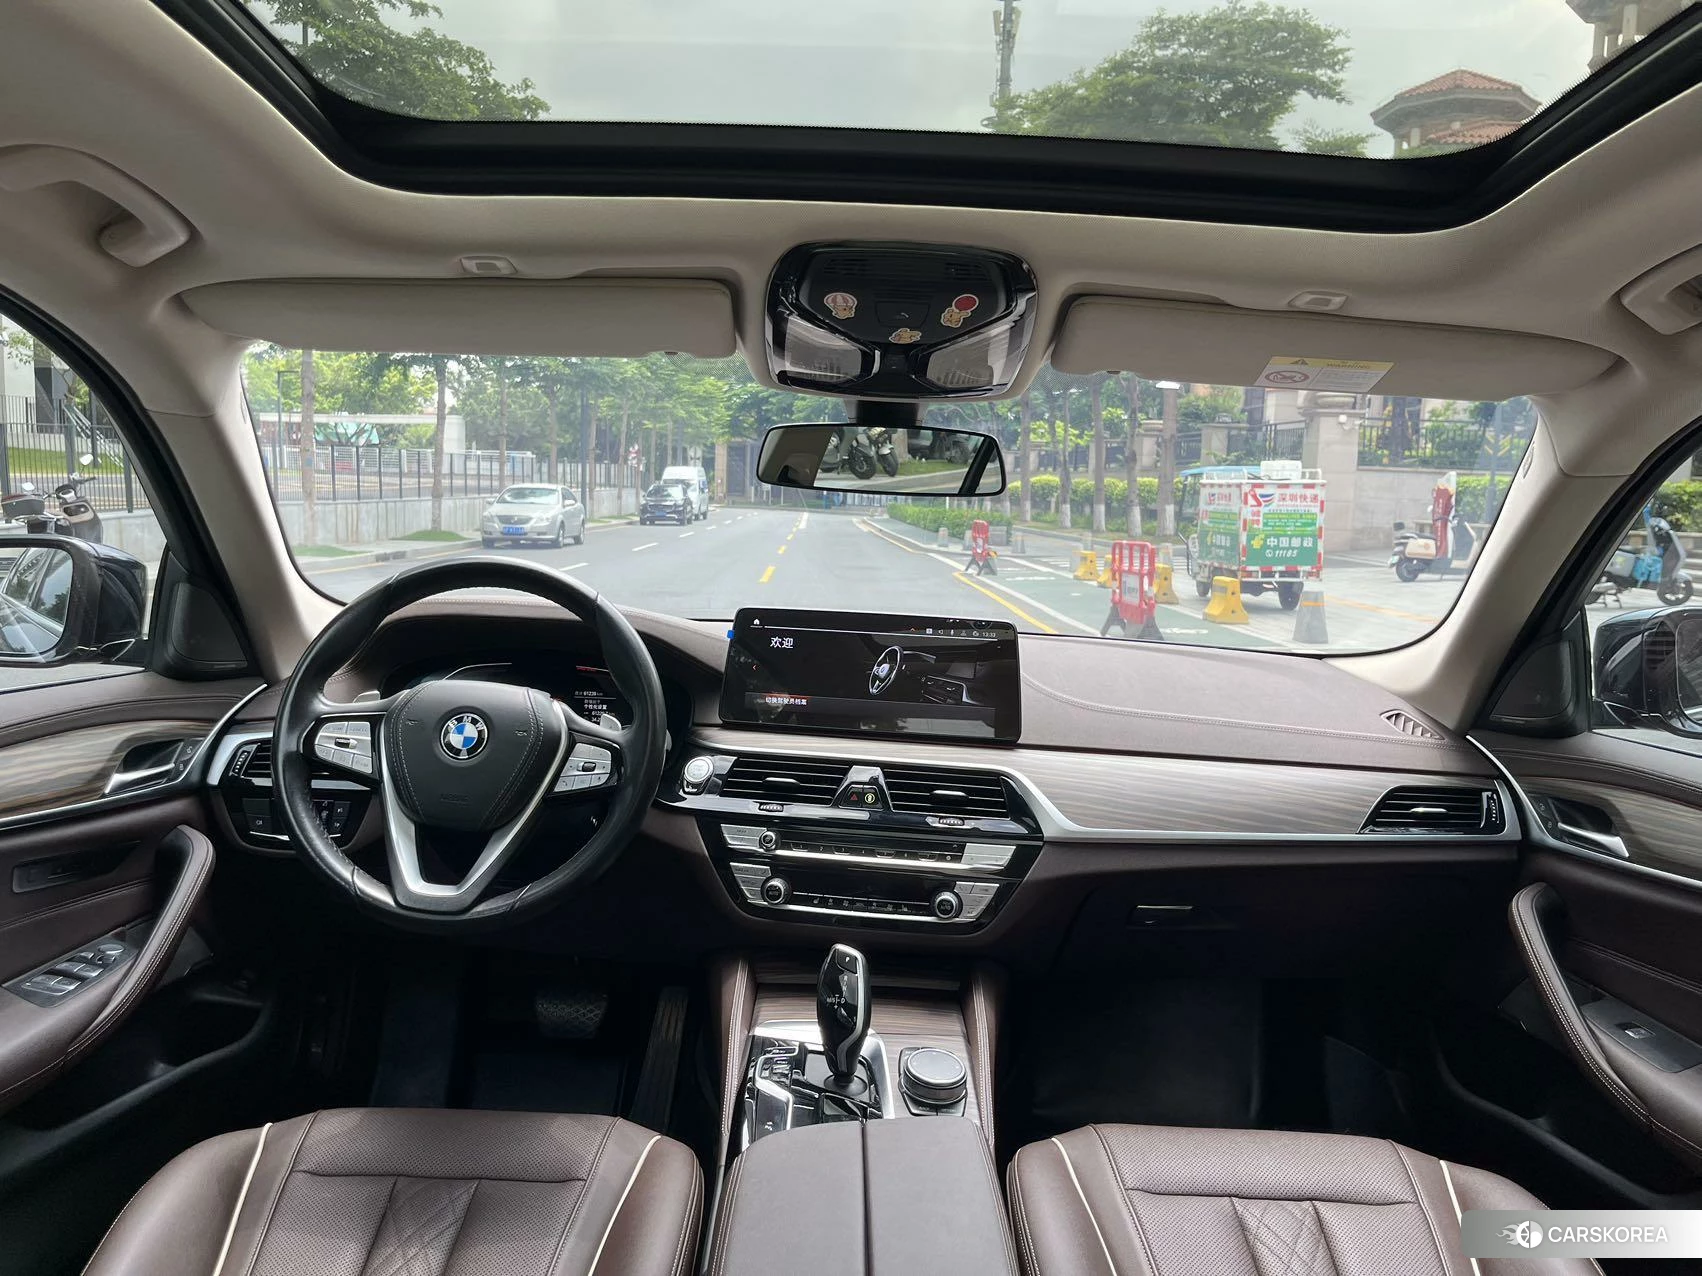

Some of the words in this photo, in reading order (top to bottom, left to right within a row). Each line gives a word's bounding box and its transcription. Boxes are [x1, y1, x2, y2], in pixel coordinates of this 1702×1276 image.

[1266, 536, 1313, 548] 中国邮政
[1275, 550, 1298, 558] 11185
[770, 637, 794, 649] 欢迎
[448, 715, 484, 731] BMW
